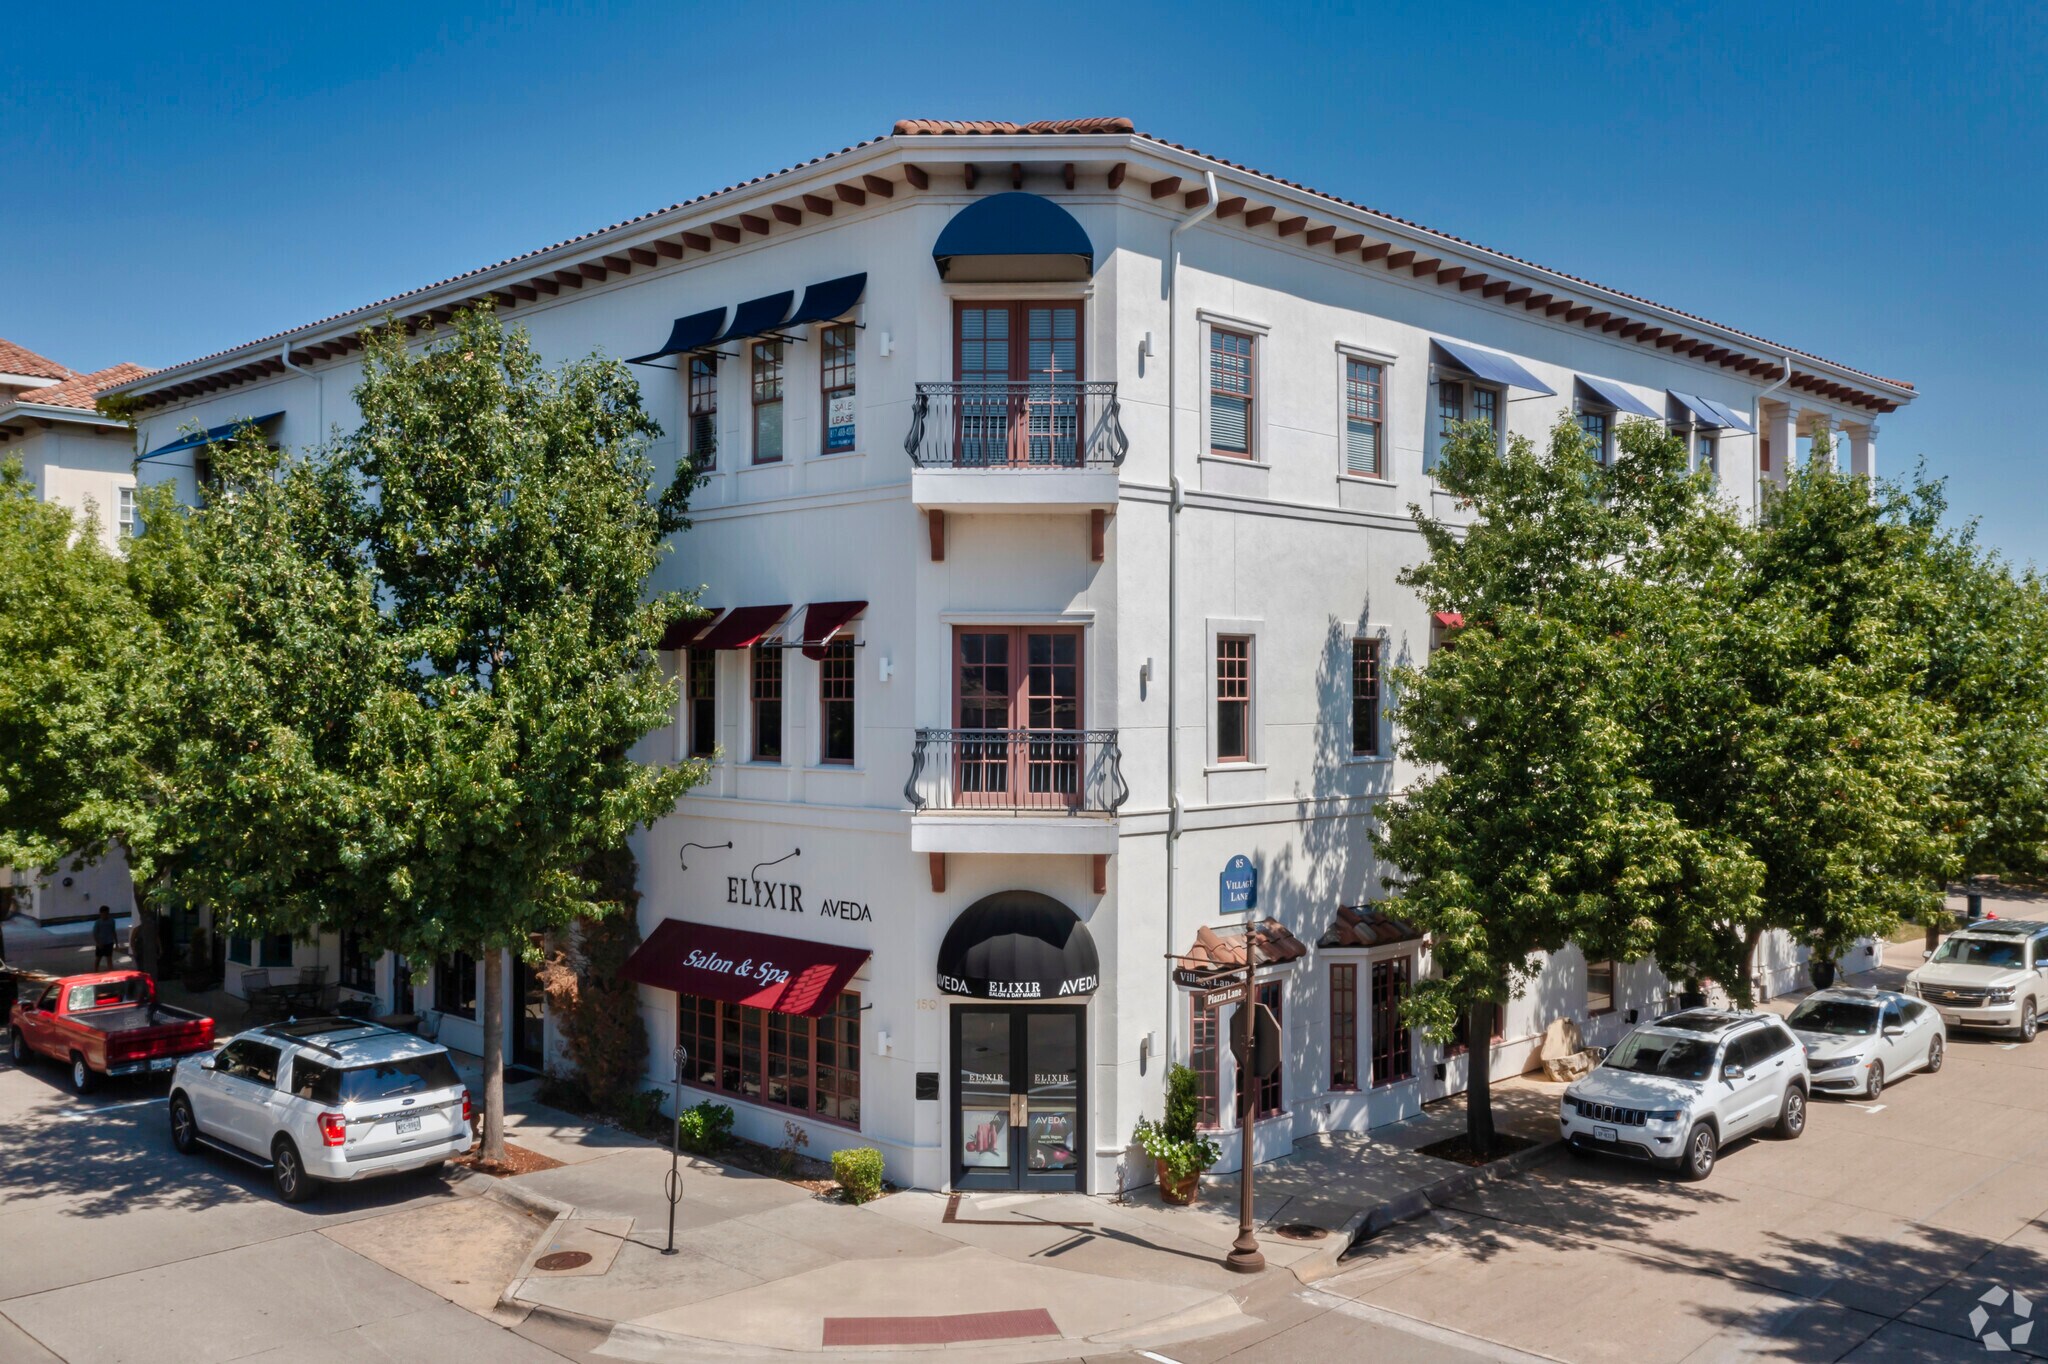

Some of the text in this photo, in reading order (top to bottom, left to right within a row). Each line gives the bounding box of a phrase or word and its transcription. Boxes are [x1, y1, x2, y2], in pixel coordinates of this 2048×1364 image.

[834, 402, 852, 412] SALE
[832, 414, 854, 425] LEASE
[1235, 859, 1244, 868] 85
[1226, 880, 1254, 890] VILLAGE
[727, 876, 804, 913] ELIXIR
[1230, 892, 1249, 902] LANE
[820, 899, 872, 922] AVEDA
[683, 949, 790, 987] Salon & Spa
[989, 981, 1041, 993] ELIXIR
[1058, 974, 1097, 996] AVEDA
[1207, 988, 1242, 1005] Piazza Lane
[969, 1073, 1004, 1081] ELIXIR
[1034, 1074, 1069, 1082] ELIXIR
[1035, 1116, 1067, 1124] AVEDA
